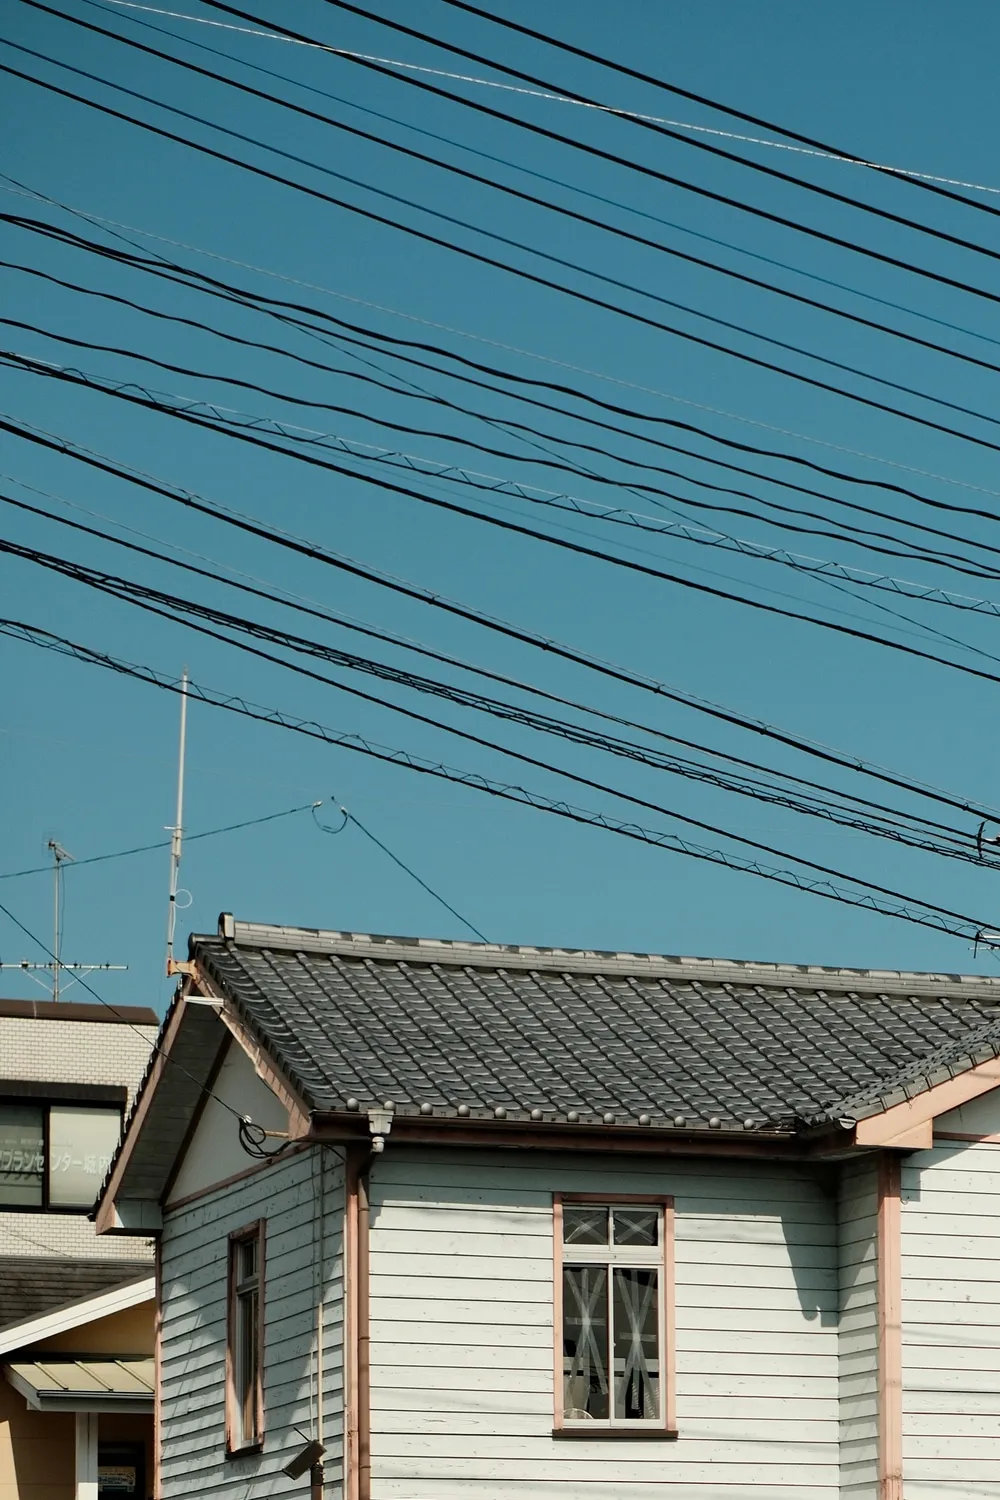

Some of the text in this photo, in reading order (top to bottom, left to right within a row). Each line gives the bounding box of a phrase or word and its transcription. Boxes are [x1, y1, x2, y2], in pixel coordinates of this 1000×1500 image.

[0, 1149, 112, 1175] プランセンター城内
